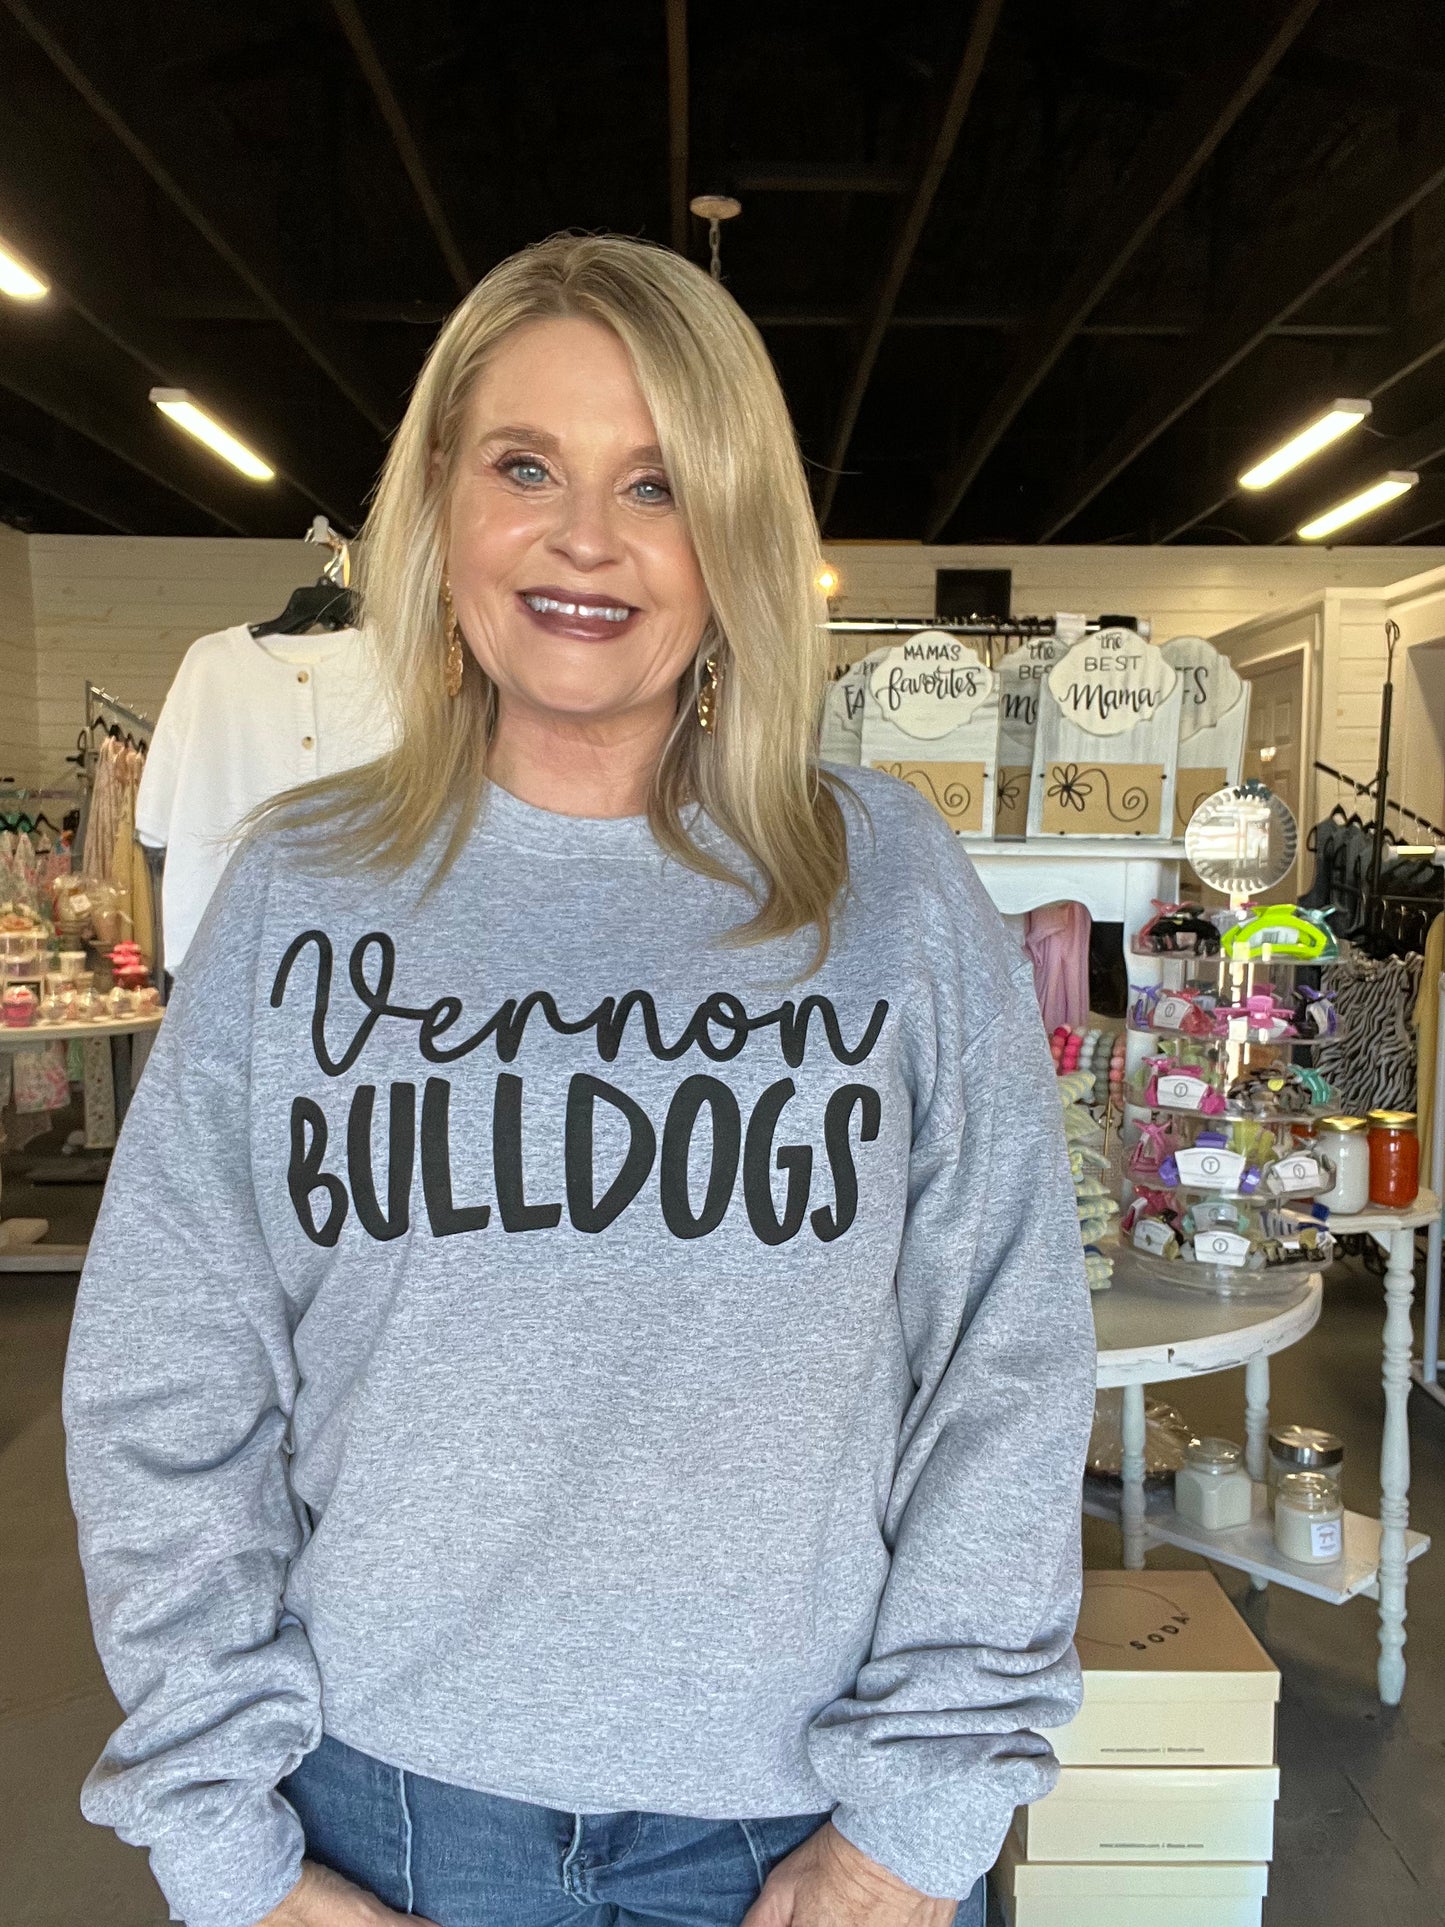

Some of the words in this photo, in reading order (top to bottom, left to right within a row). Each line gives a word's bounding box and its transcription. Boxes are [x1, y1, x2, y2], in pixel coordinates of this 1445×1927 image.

[1096, 631, 1123, 650] the
[1084, 655, 1142, 672] BEST
[875, 666, 985, 711] favorites
[1058, 683, 1160, 719] Mama
[269, 929, 890, 1077] Vernon
[287, 1072, 882, 1247] BULLDOGS
[1129, 1615, 1190, 1650] SODA
